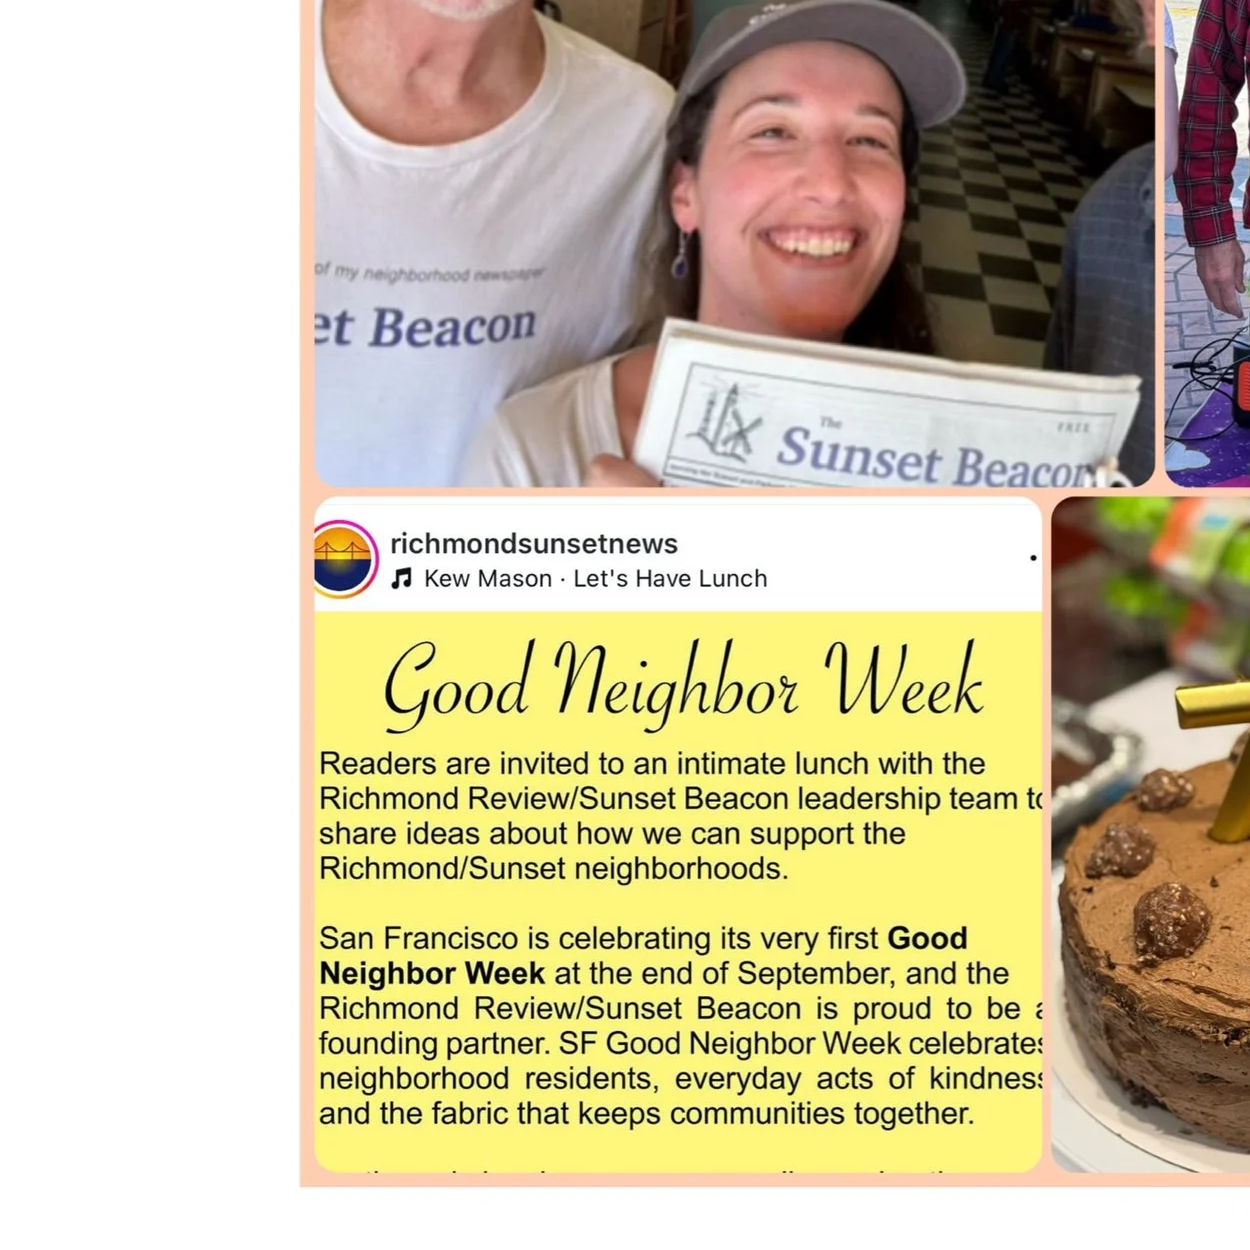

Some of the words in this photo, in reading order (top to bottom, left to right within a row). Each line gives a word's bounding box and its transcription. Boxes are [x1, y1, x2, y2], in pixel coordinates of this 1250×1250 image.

[314, 261, 331, 276] of
[335, 265, 358, 280] my
[363, 266, 470, 285] neighborhood
[473, 267, 546, 283] newspaper
[368, 306, 537, 348] Beacon
[820, 416, 843, 430] The
[777, 426, 943, 486] Sunset
[391, 531, 678, 555] richmondsunsetnews
[425, 568, 471, 588] Kew
[478, 568, 552, 588] Mason
[574, 569, 629, 588] Let's
[636, 568, 692, 588] Have
[699, 568, 768, 588] Lunch
[384, 637, 536, 735] Good
[554, 638, 799, 734] Neighbor
[824, 638, 984, 715] Week
[320, 750, 437, 776] Readers
[446, 756, 491, 776] are
[500, 750, 589, 776] invited
[598, 751, 625, 776] to
[633, 756, 667, 775] an
[678, 750, 786, 776] intimate
[796, 750, 869, 776] lunch
[878, 750, 933, 775] with
[942, 750, 986, 776] the
[320, 855, 566, 880] Richmond/Sunset
[575, 855, 788, 886] neighborhoods.
[319, 1100, 370, 1125] and
[379, 1100, 423, 1125] the
[431, 1100, 509, 1125] fabric
[516, 1100, 570, 1125] that
[579, 1100, 661, 1131] keeps
[670, 1100, 845, 1125] communities
[853, 1100, 974, 1131] together.
